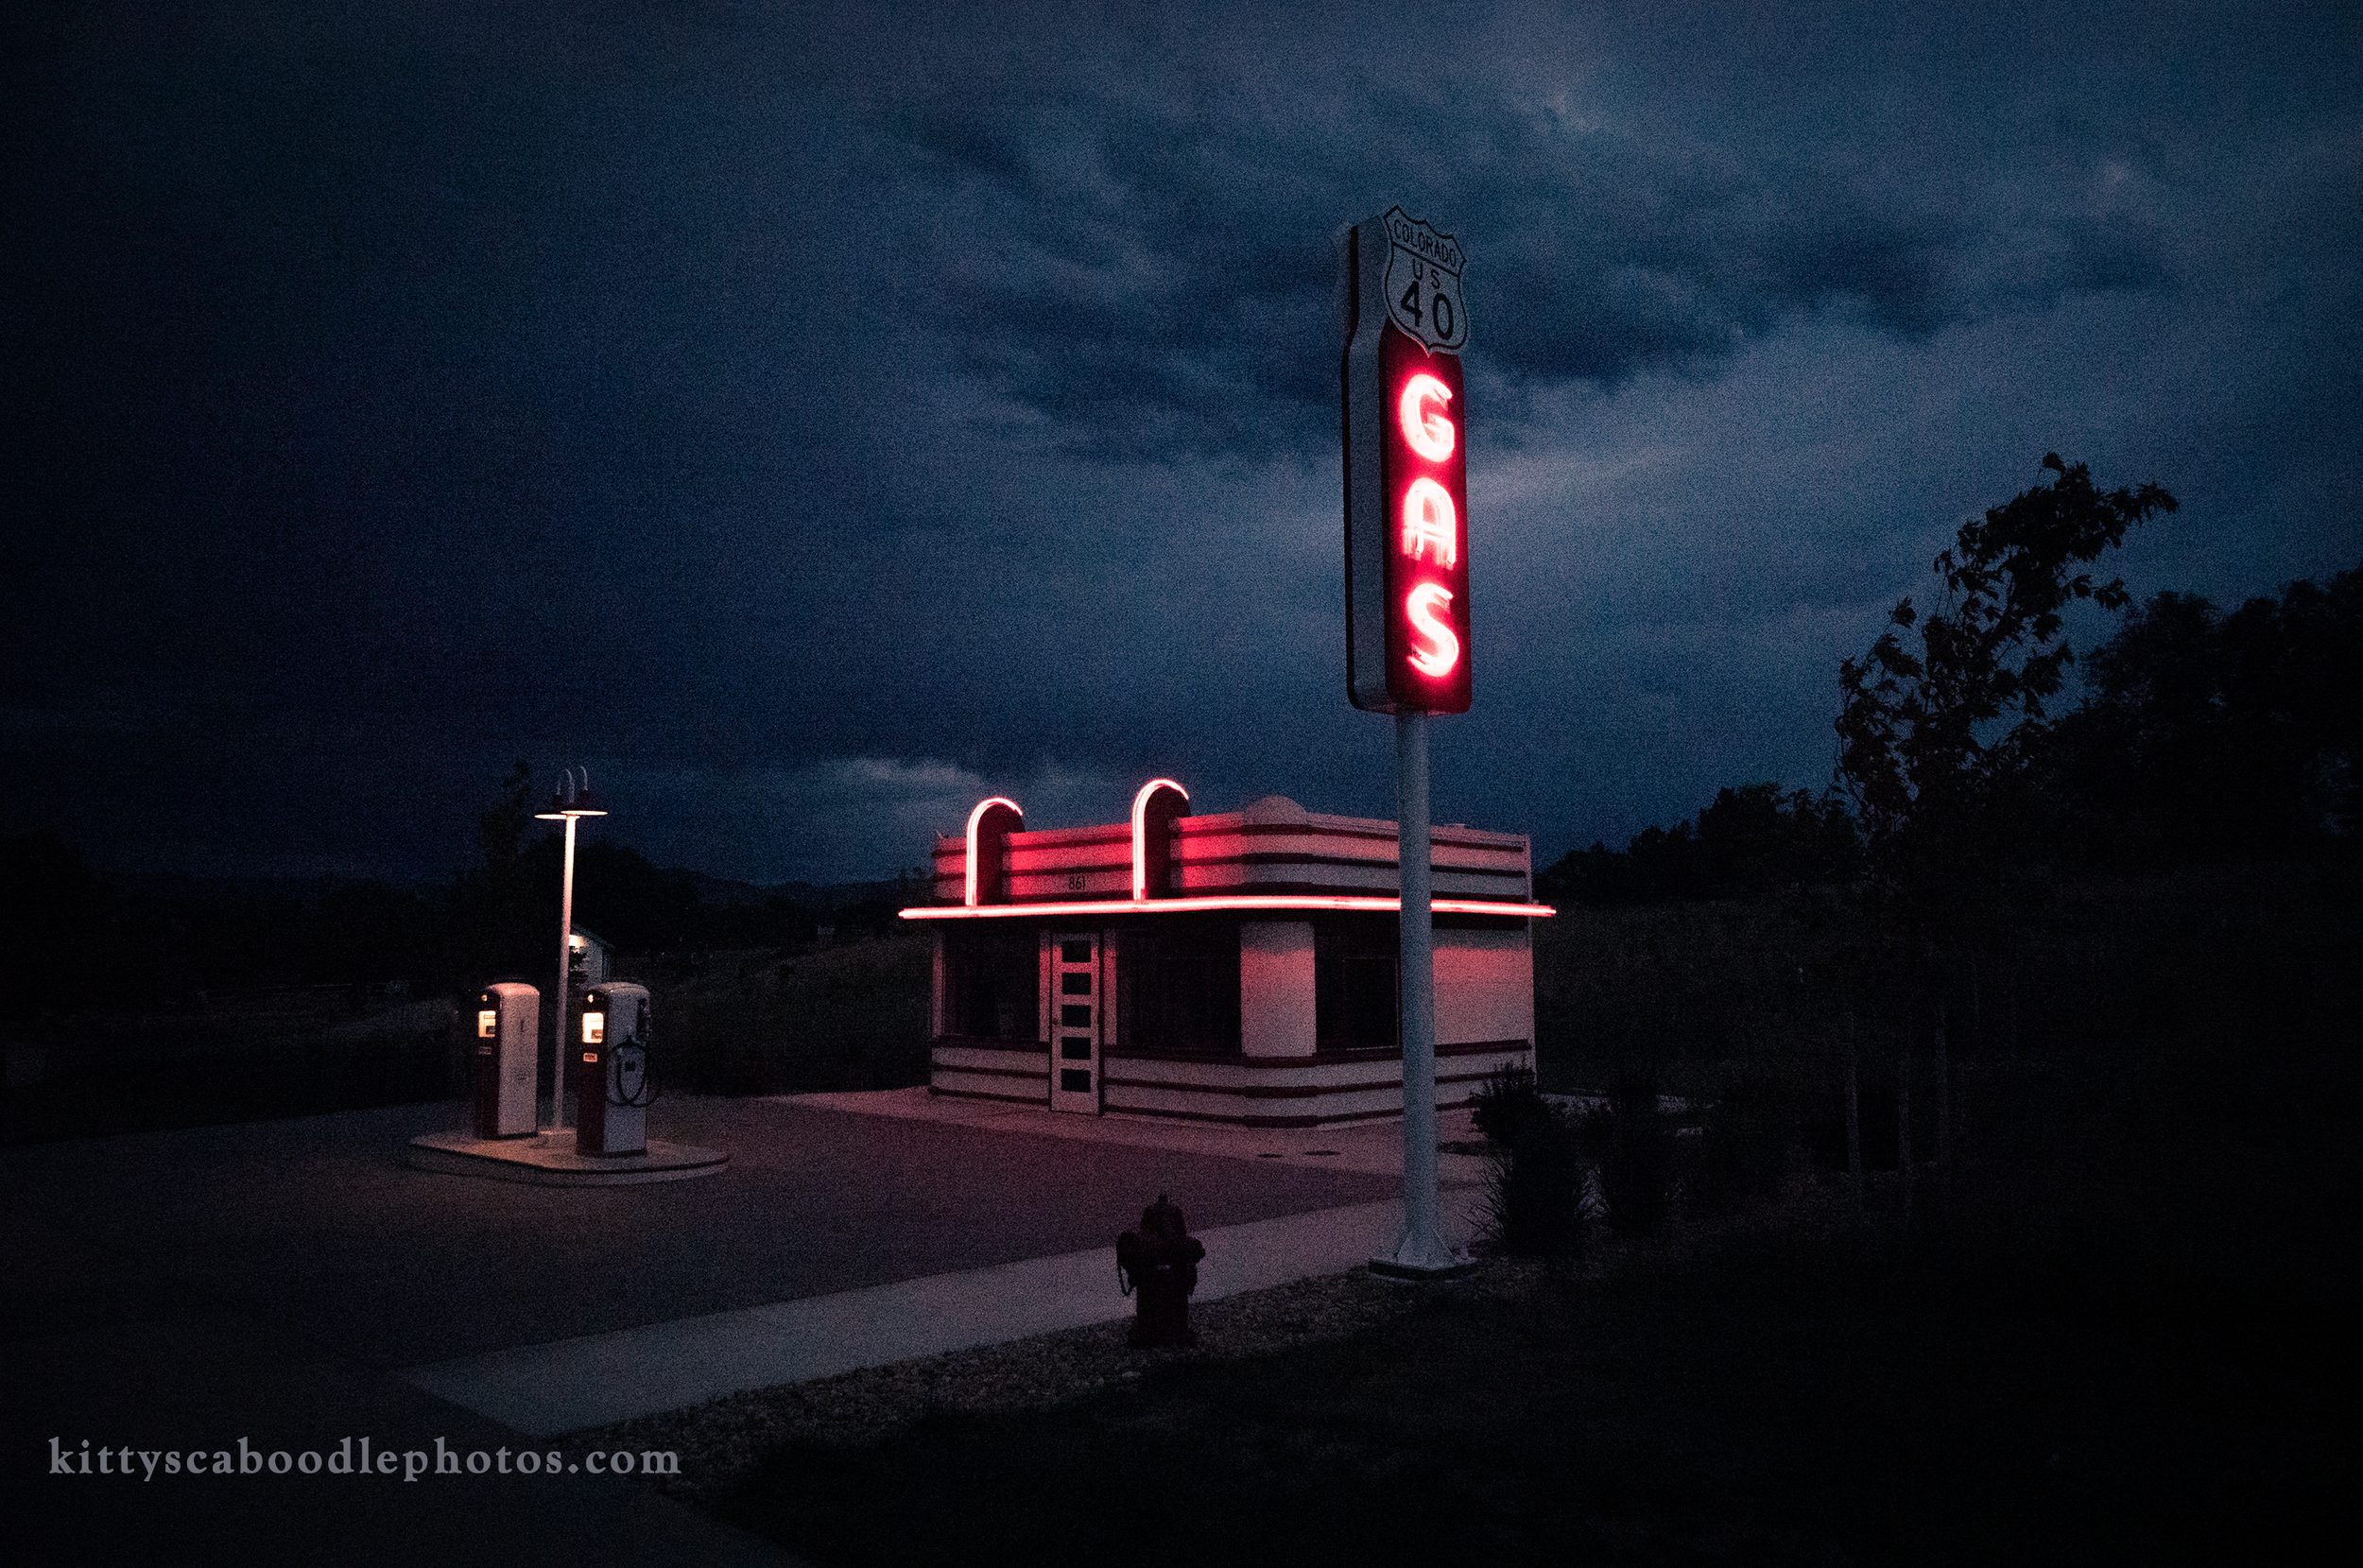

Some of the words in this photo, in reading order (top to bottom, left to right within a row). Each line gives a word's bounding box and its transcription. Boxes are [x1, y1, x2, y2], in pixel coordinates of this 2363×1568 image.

[1394, 219, 1457, 267] COLORADO
[1400, 281, 1454, 340] 40
[1402, 374, 1459, 677] GAS
[1068, 876, 1086, 890] 861
